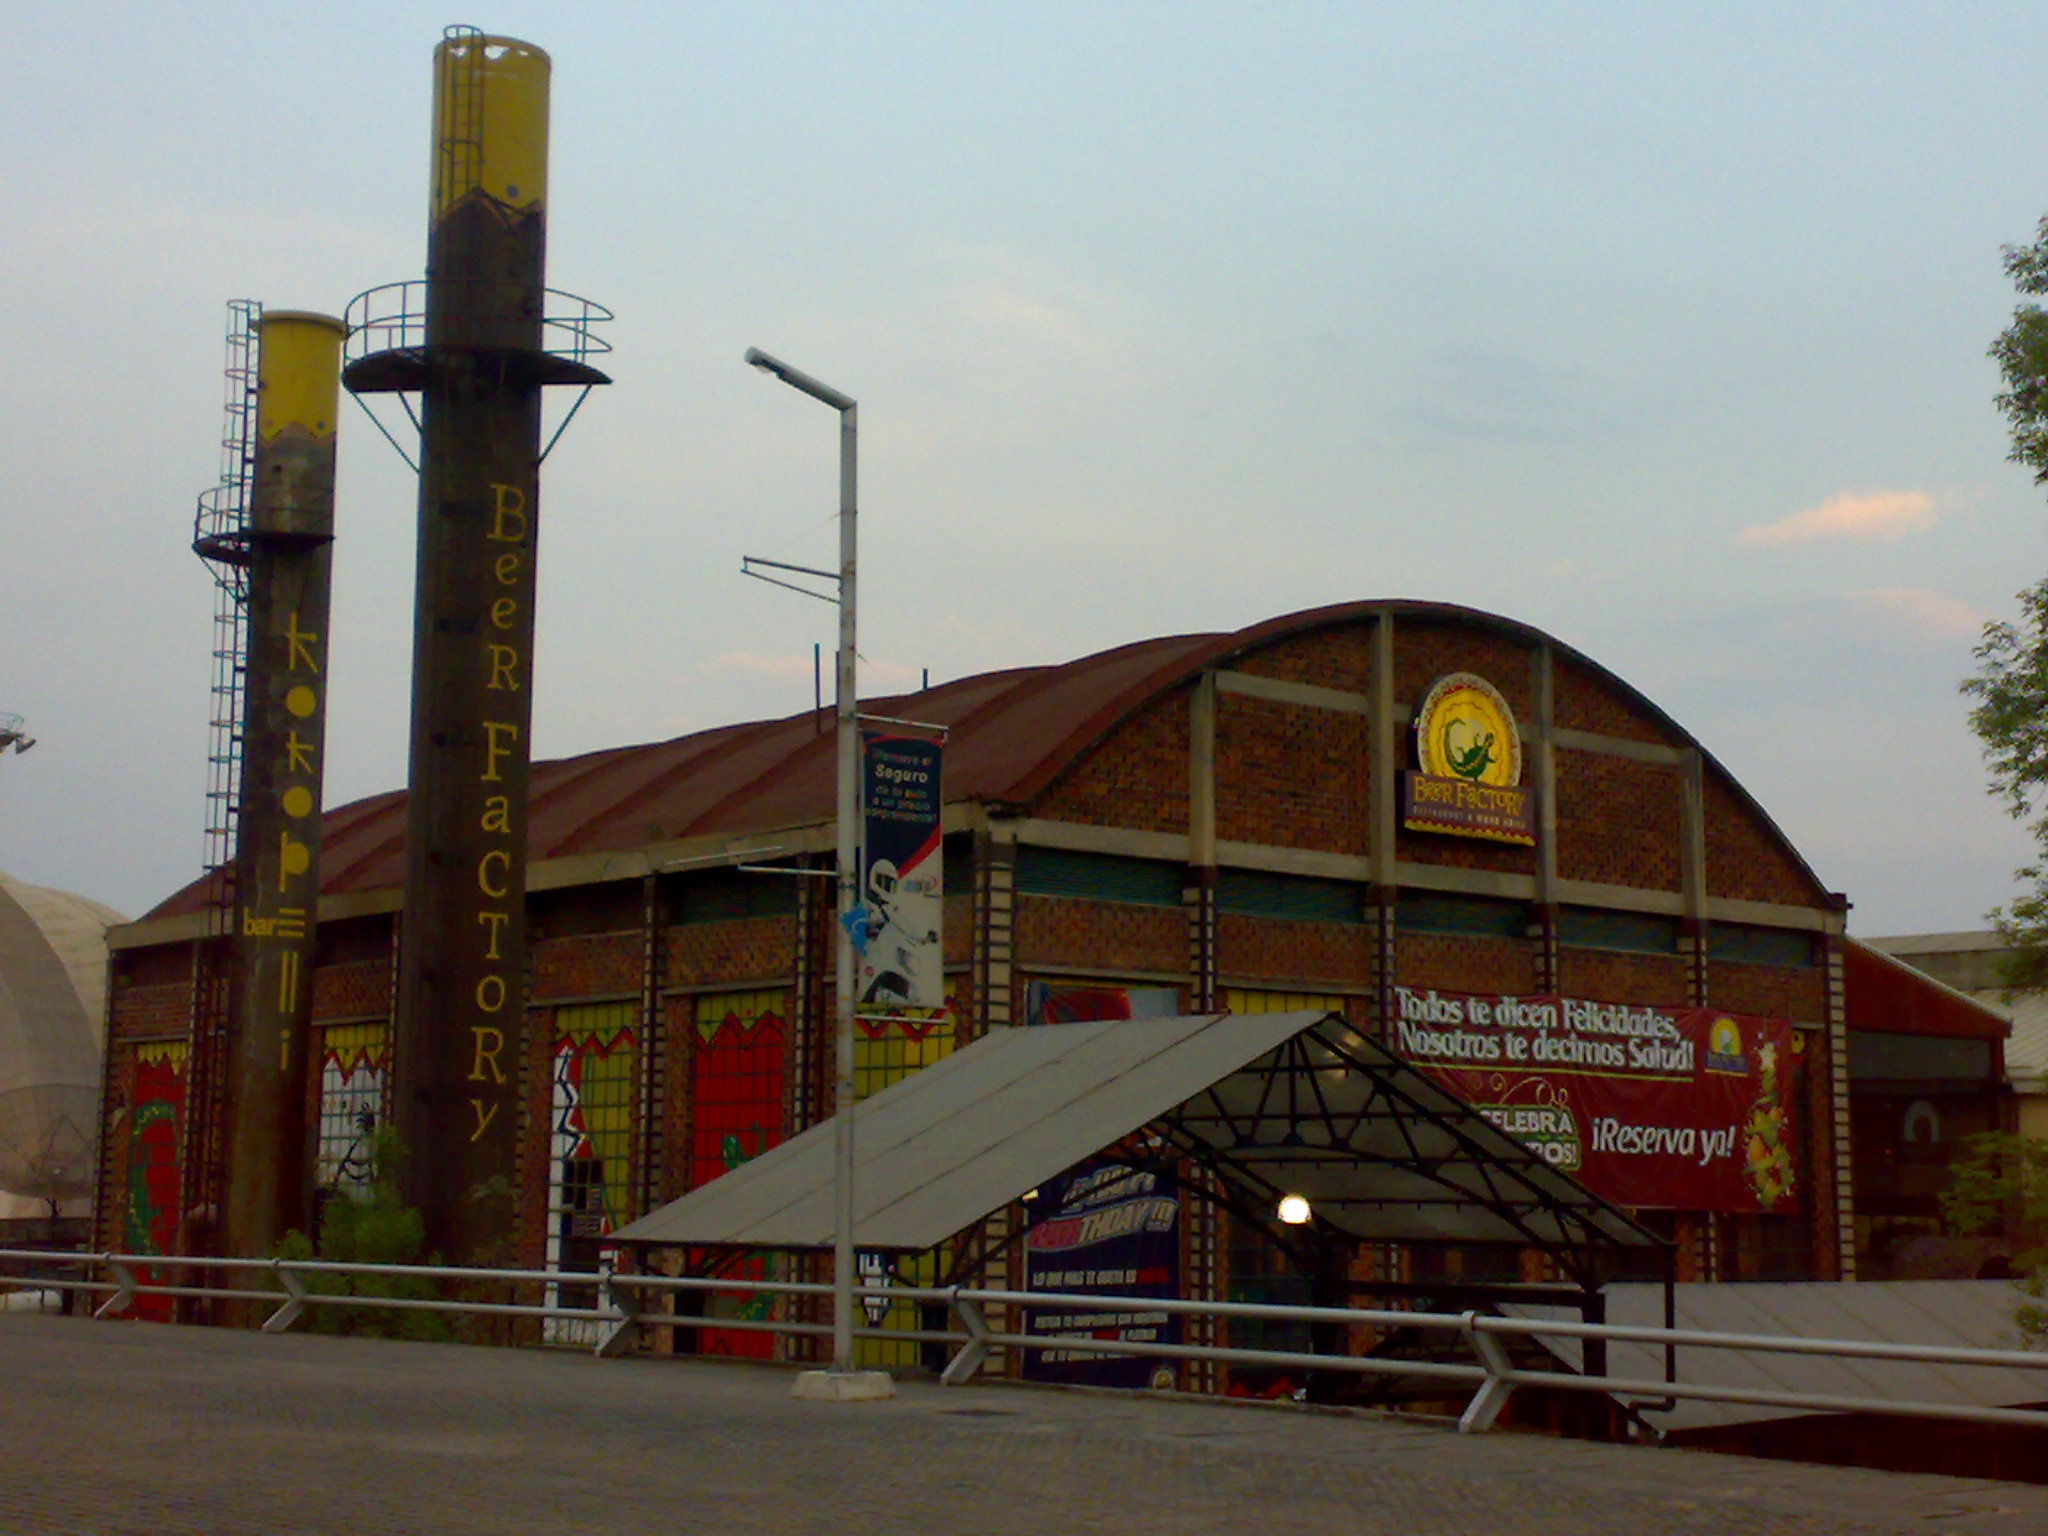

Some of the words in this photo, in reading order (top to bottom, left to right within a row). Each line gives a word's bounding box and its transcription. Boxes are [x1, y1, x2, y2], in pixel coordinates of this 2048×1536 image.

[875, 764, 928, 784] Seguro
[243, 907, 277, 936] bar
[1395, 987, 1463, 1024] Todos
[1467, 996, 1491, 1025] te
[1495, 995, 1557, 1028] dicen
[1562, 999, 1681, 1043] Felicidades,
[1397, 1020, 1499, 1059] Nosotros
[1505, 1031, 1529, 1060] te
[1531, 1029, 1626, 1068] decimos
[1628, 1037, 1694, 1072] Salud!
[1480, 1110, 1573, 1134] ELEBRA
[1592, 1117, 1694, 1156] ¡Reserva
[1698, 1126, 1736, 1166] ya!
